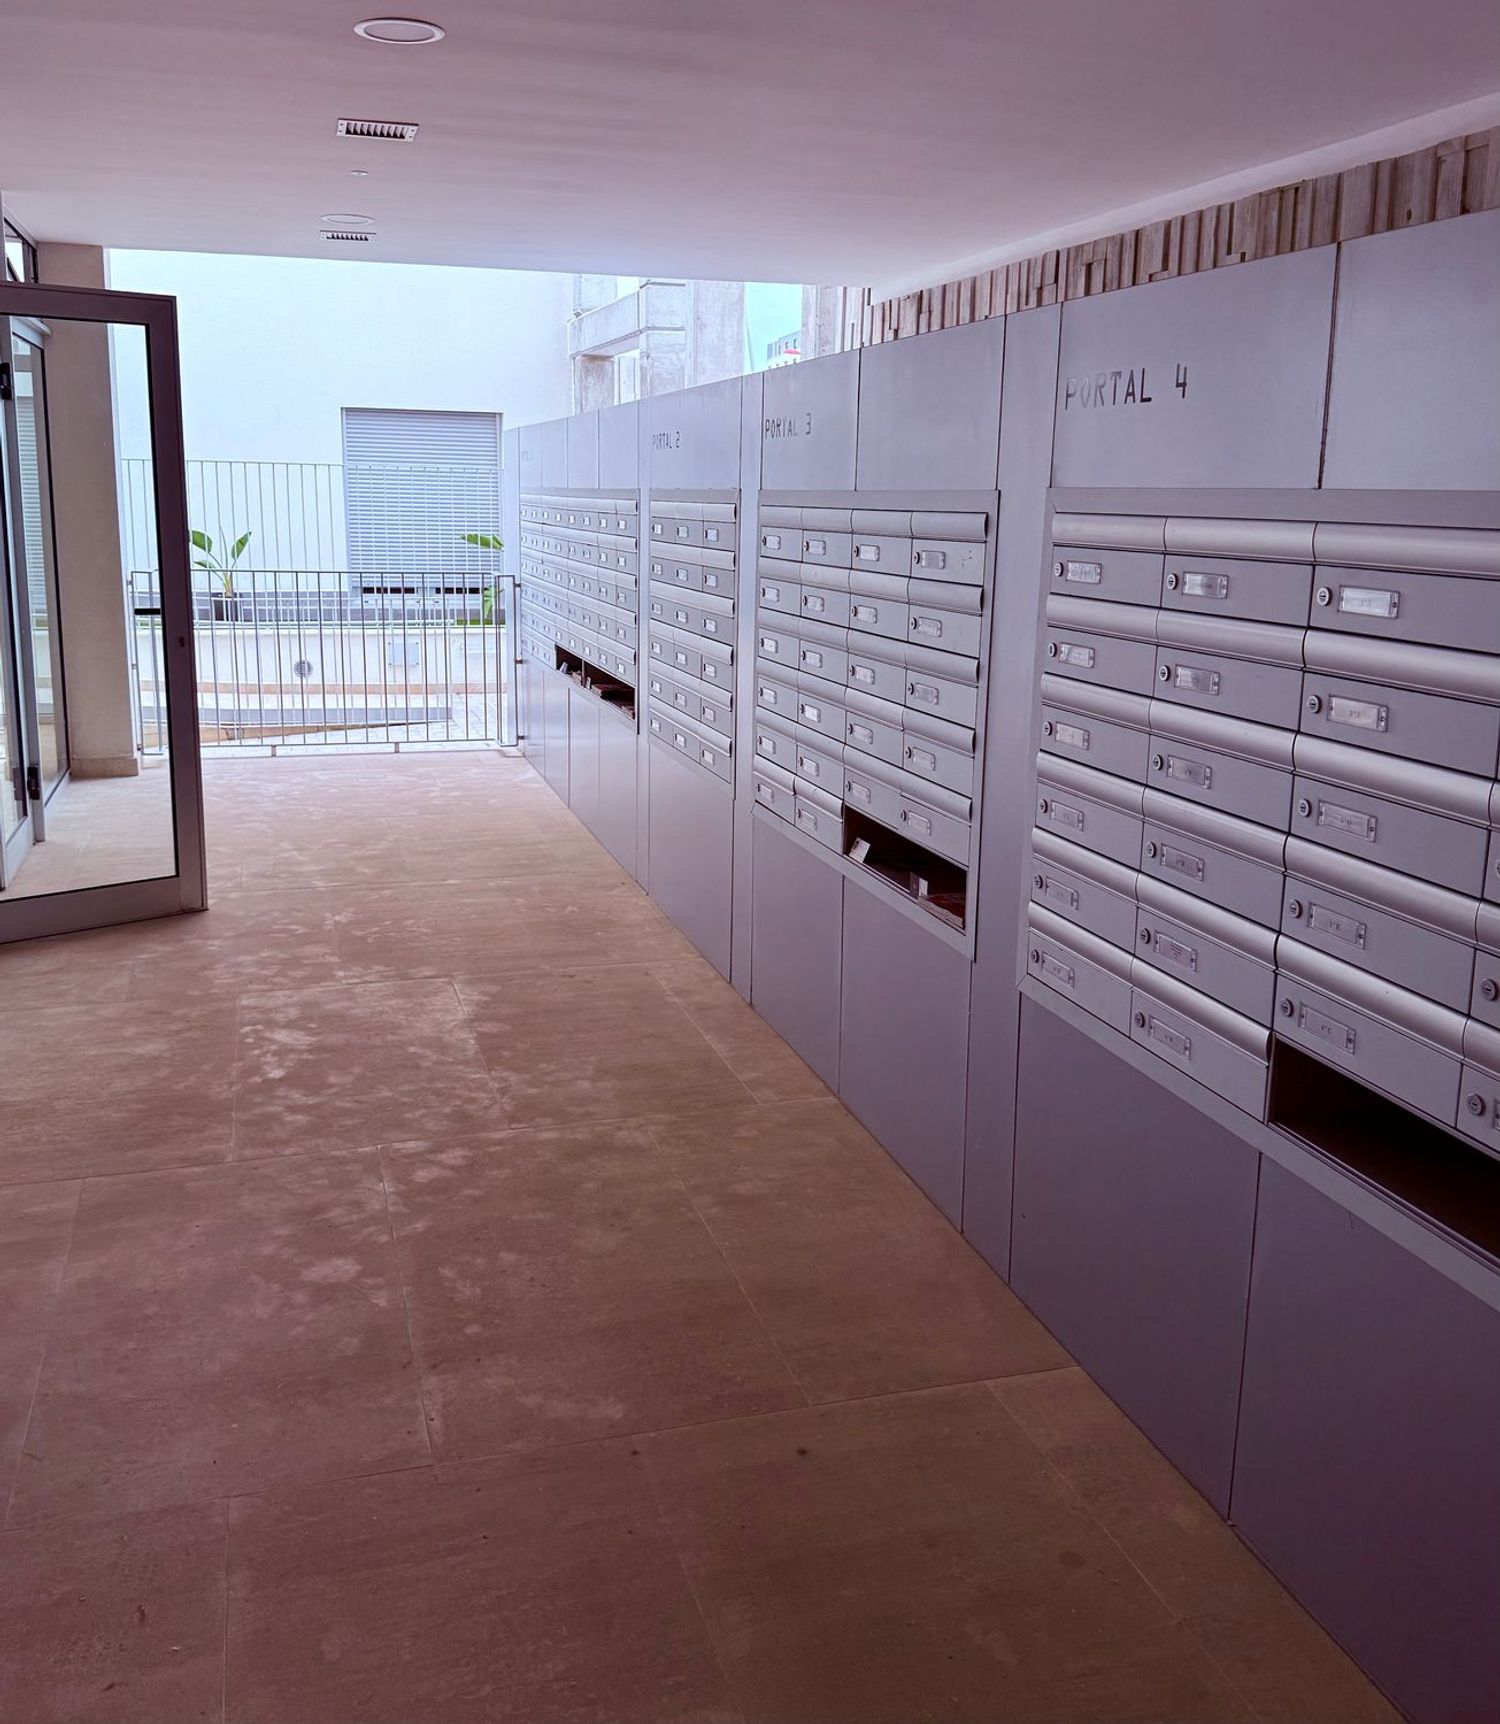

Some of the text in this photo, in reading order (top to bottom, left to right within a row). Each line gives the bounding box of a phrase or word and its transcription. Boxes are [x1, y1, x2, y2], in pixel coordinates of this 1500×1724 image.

[1065, 362, 1188, 410] PORTAL 4
[675, 430, 681, 449] 2
[765, 412, 812, 440] PORTAL 3
